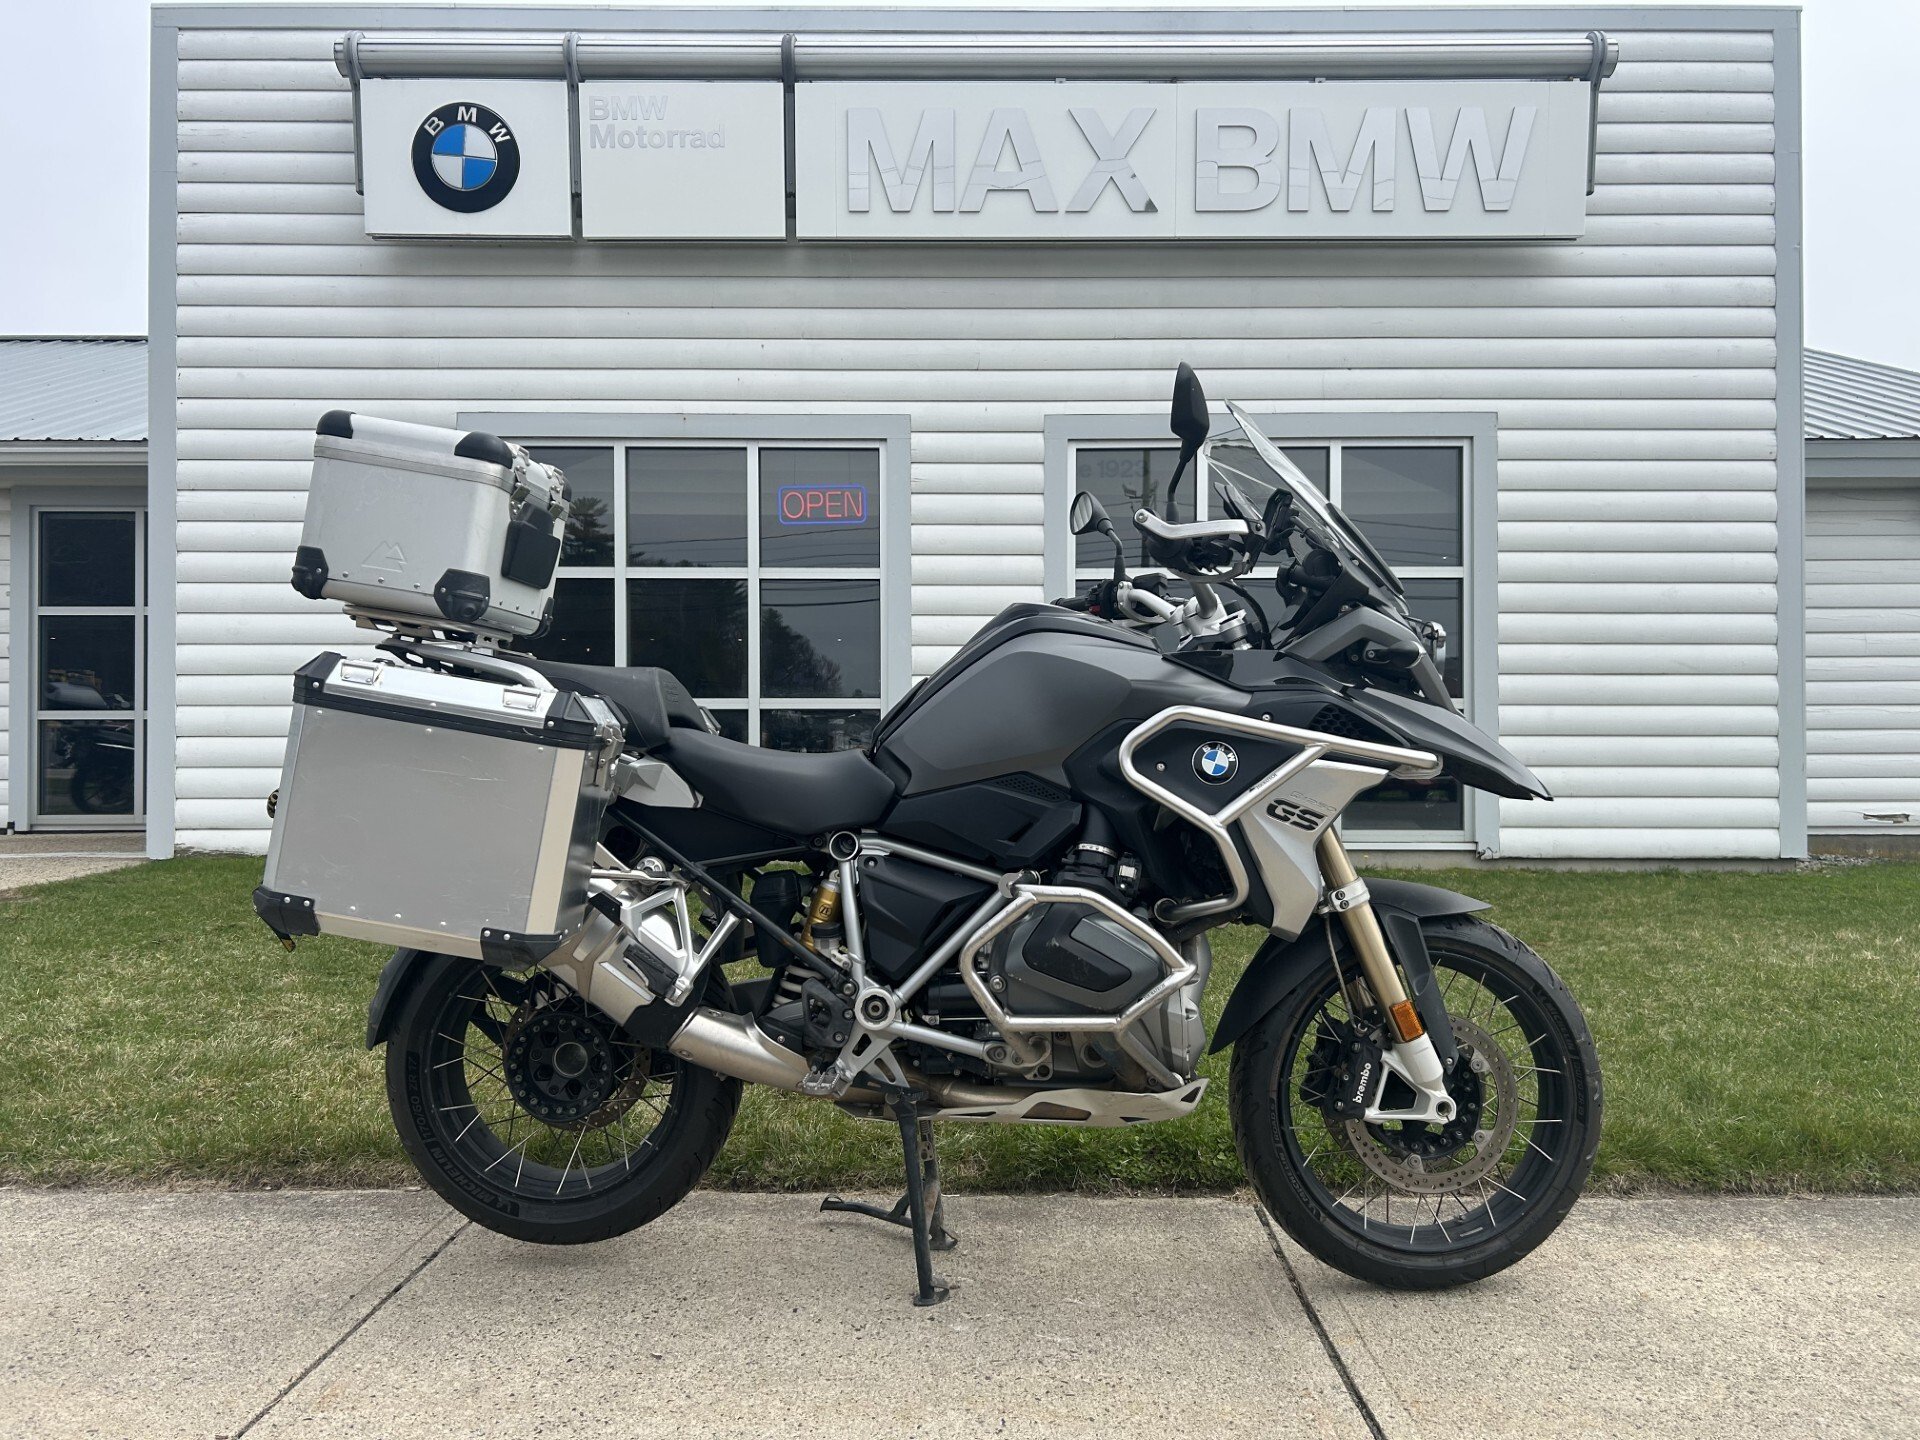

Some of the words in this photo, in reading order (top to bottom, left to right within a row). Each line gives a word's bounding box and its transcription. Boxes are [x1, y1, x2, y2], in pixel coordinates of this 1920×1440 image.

[588, 95, 669, 121] BMW
[424, 105, 512, 144] BMW
[589, 123, 726, 149] Motorrad
[847, 106, 1158, 213] MAX
[1194, 106, 1538, 213] BMW
[783, 490, 863, 519] OPEN
[1202, 744, 1236, 762] BMW
[1266, 799, 1326, 831] GS
[1352, 1062, 1372, 1105] brembo
[430, 1147, 497, 1206] MICHELIN
